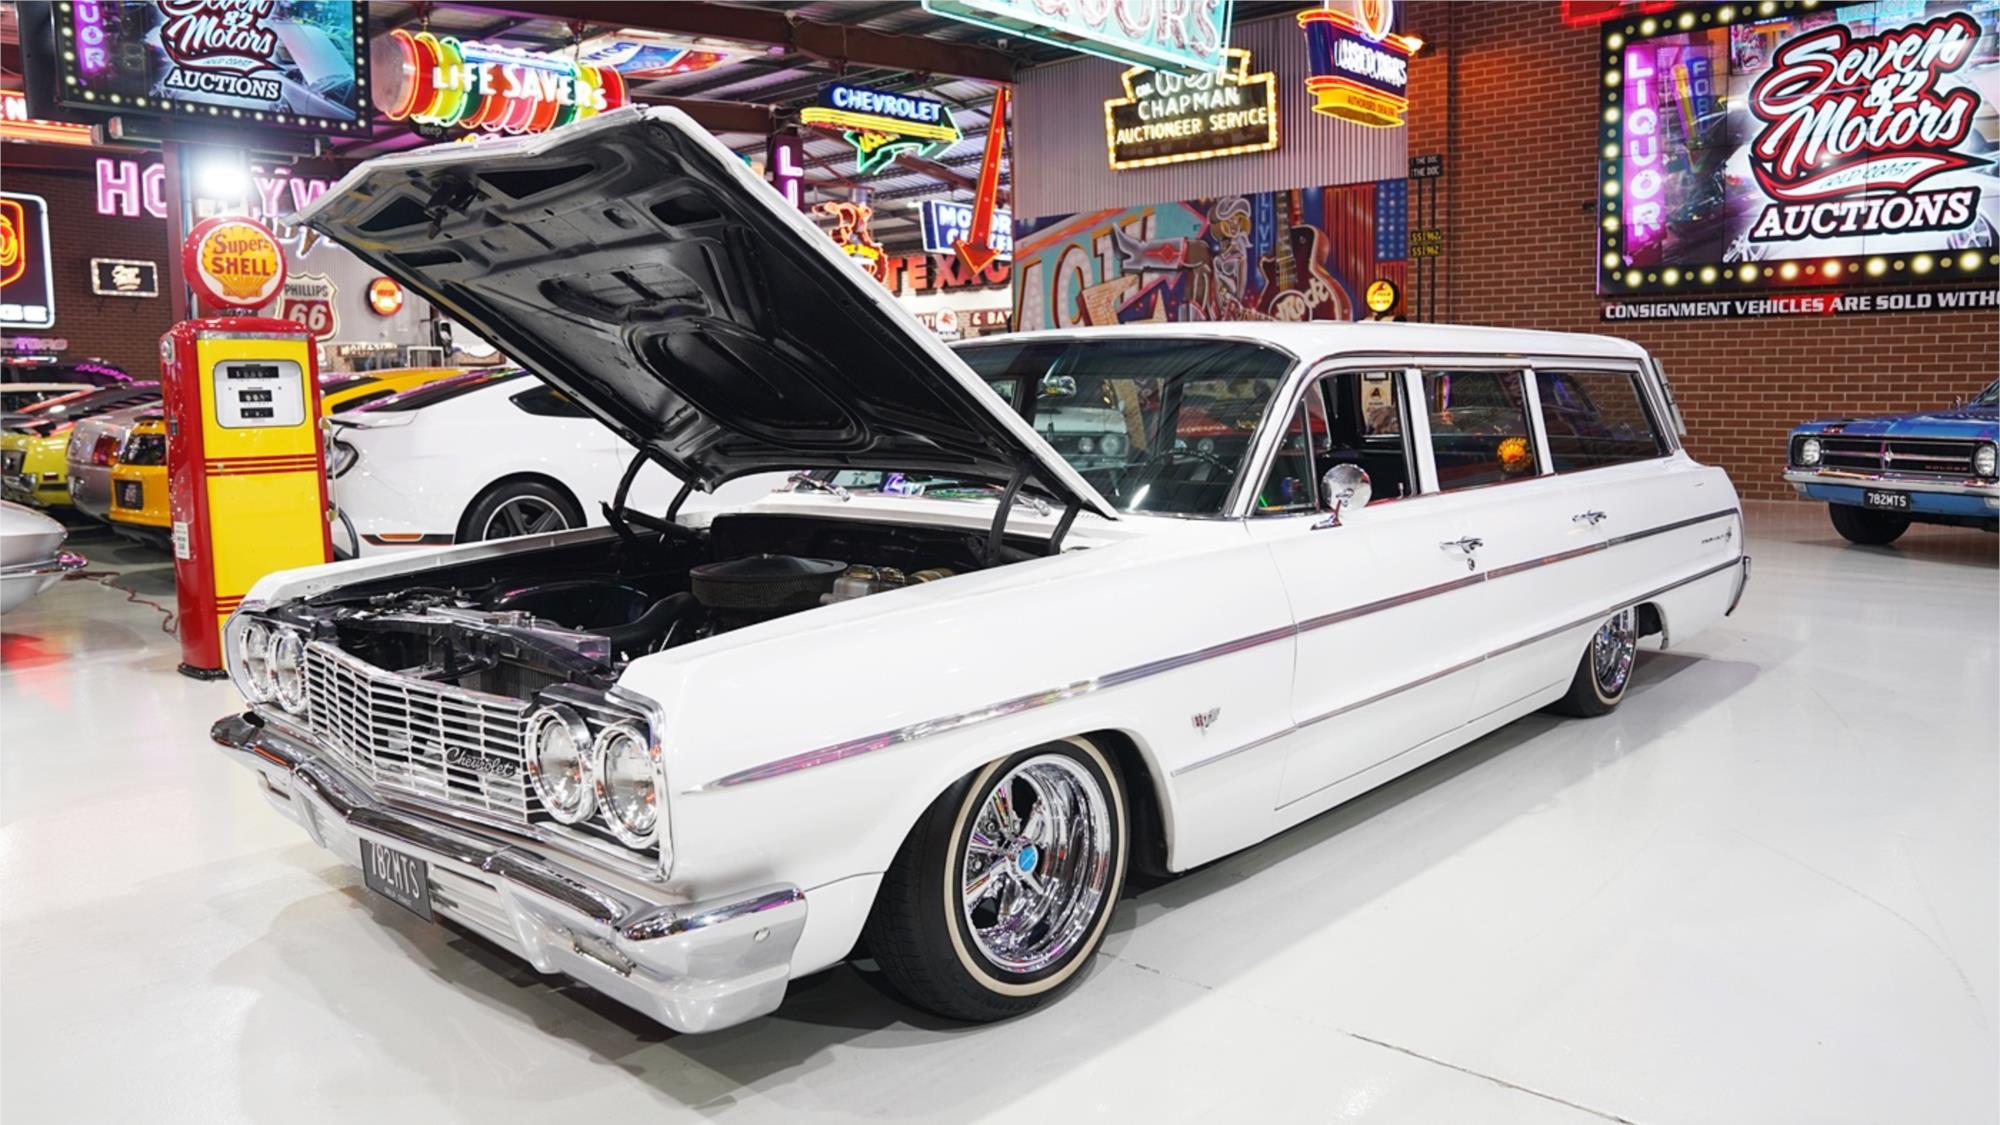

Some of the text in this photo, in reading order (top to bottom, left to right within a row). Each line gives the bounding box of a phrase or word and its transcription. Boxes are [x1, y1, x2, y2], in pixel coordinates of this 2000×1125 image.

[166, 14, 273, 54] Motors
[166, 69, 280, 99] AUCTIONS
[1760, 23, 1969, 115] Seven
[433, 64, 608, 111] LIFE SAVERS
[832, 86, 942, 122] CHEVROLET
[1138, 87, 1241, 120] CHAPMAN
[1864, 71, 1930, 108] 82
[1116, 107, 1268, 145] AUCTIONEER SERVICE
[1760, 97, 1969, 179] Motors
[1628, 53, 1663, 237] LIQUOR
[1753, 190, 1972, 238] AUCTIONS
[211, 256, 271, 277] SHELL
[285, 284, 329, 297] PHILLIPS
[1605, 290, 2000, 319] CONSIGNMENT VEHICLES ARE SOLD WITH
[289, 303, 327, 331] 66
[1867, 492, 1907, 507] 782MTS
[446, 747, 516, 778] Chevrolet
